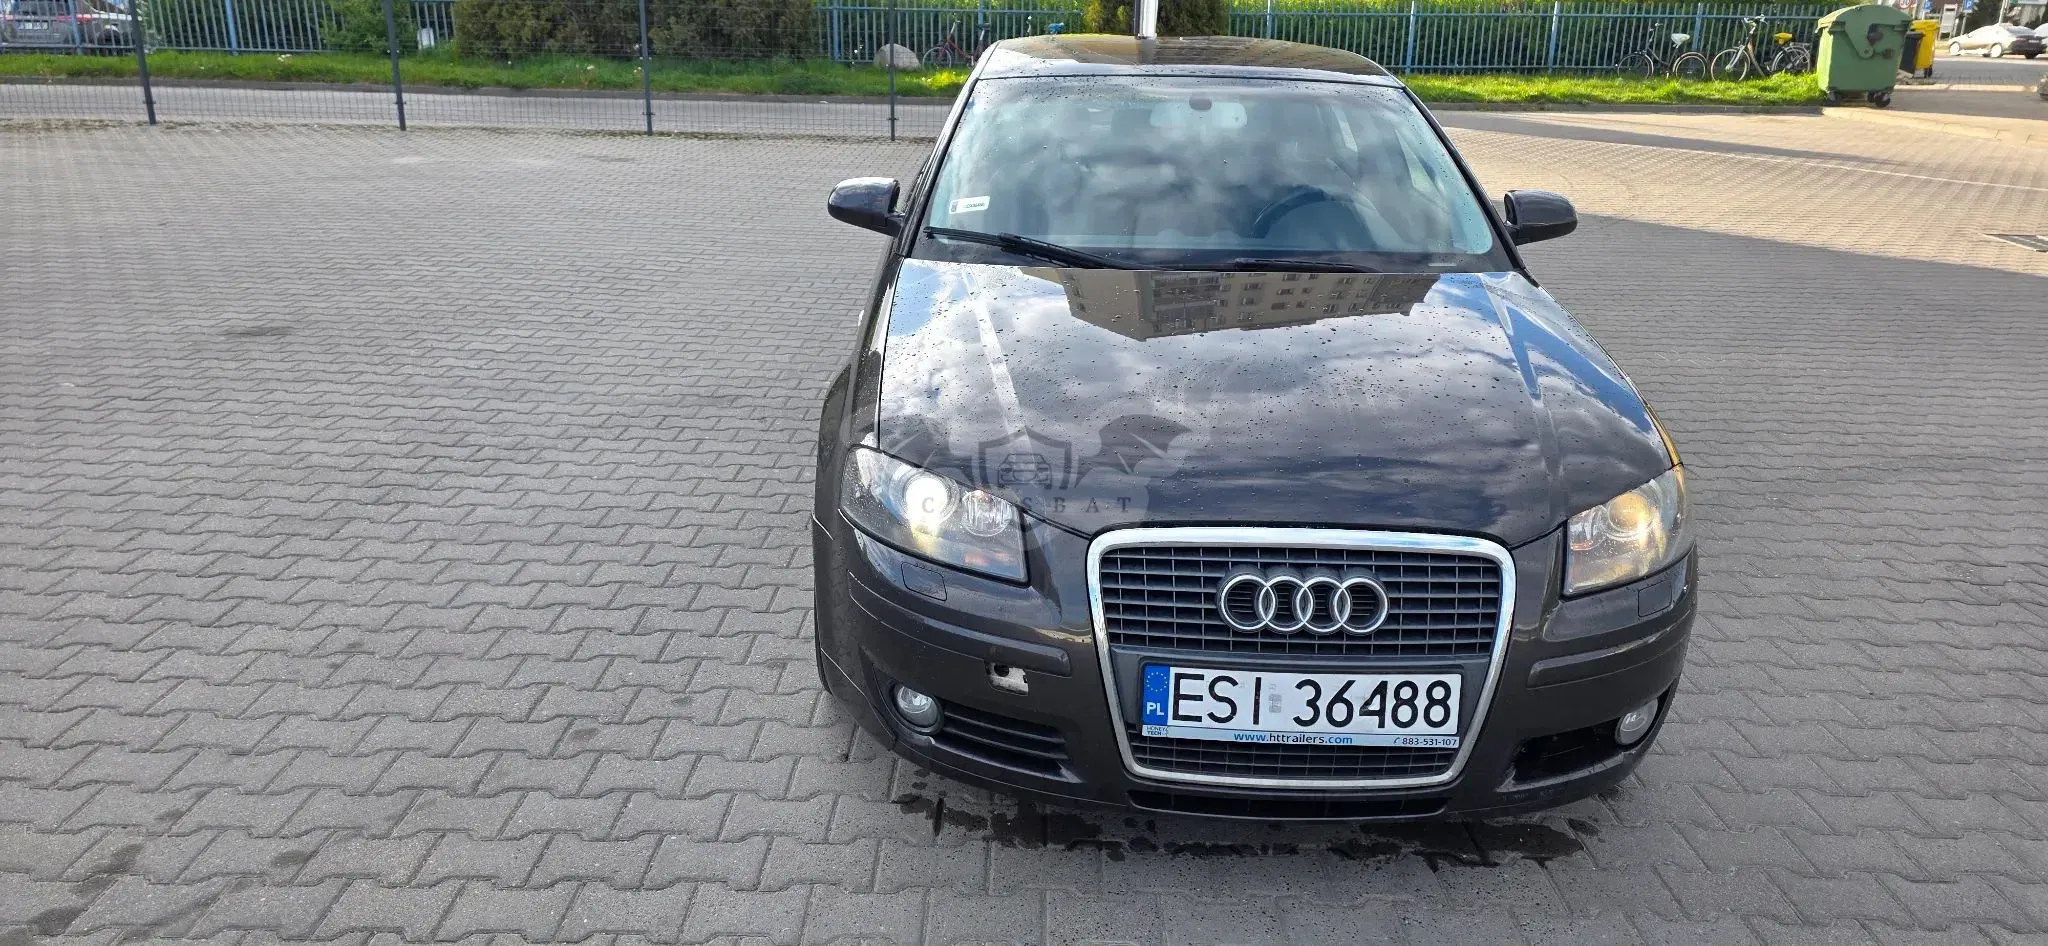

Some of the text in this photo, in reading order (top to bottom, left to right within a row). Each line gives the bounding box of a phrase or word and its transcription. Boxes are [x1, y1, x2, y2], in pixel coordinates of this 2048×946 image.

[1172, 672, 1452, 729] ESI 36488
[1146, 701, 1165, 716] PL
[1234, 733, 1353, 744] www.httrailers.com
[1402, 737, 1457, 746] 883-531-107
